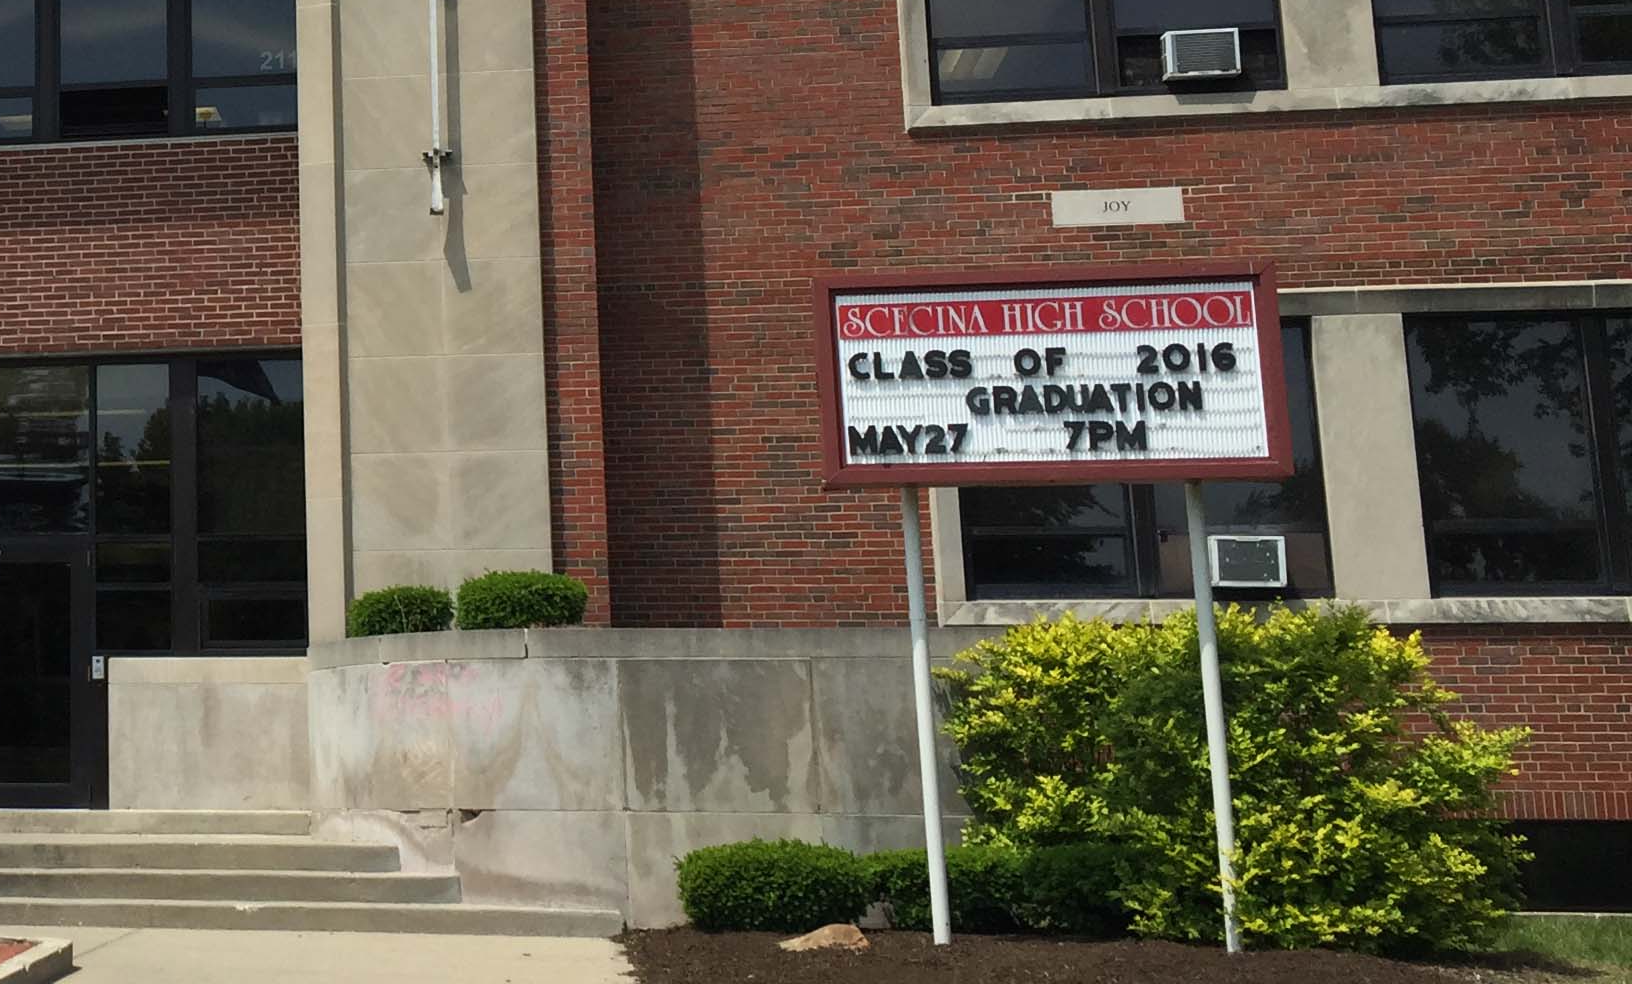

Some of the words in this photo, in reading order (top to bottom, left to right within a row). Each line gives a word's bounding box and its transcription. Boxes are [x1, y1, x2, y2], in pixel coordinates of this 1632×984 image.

[1103, 200, 1131, 213] JOY
[843, 304, 989, 337] SCECINA
[1001, 300, 1084, 332] HIGH
[1099, 295, 1252, 329] SCHOOL
[848, 349, 972, 379] CLASS
[1014, 347, 1066, 376] OF
[1137, 342, 1236, 373] 2016
[966, 381, 1203, 415] GRADUATION
[1063, 420, 1147, 451] 7PM
